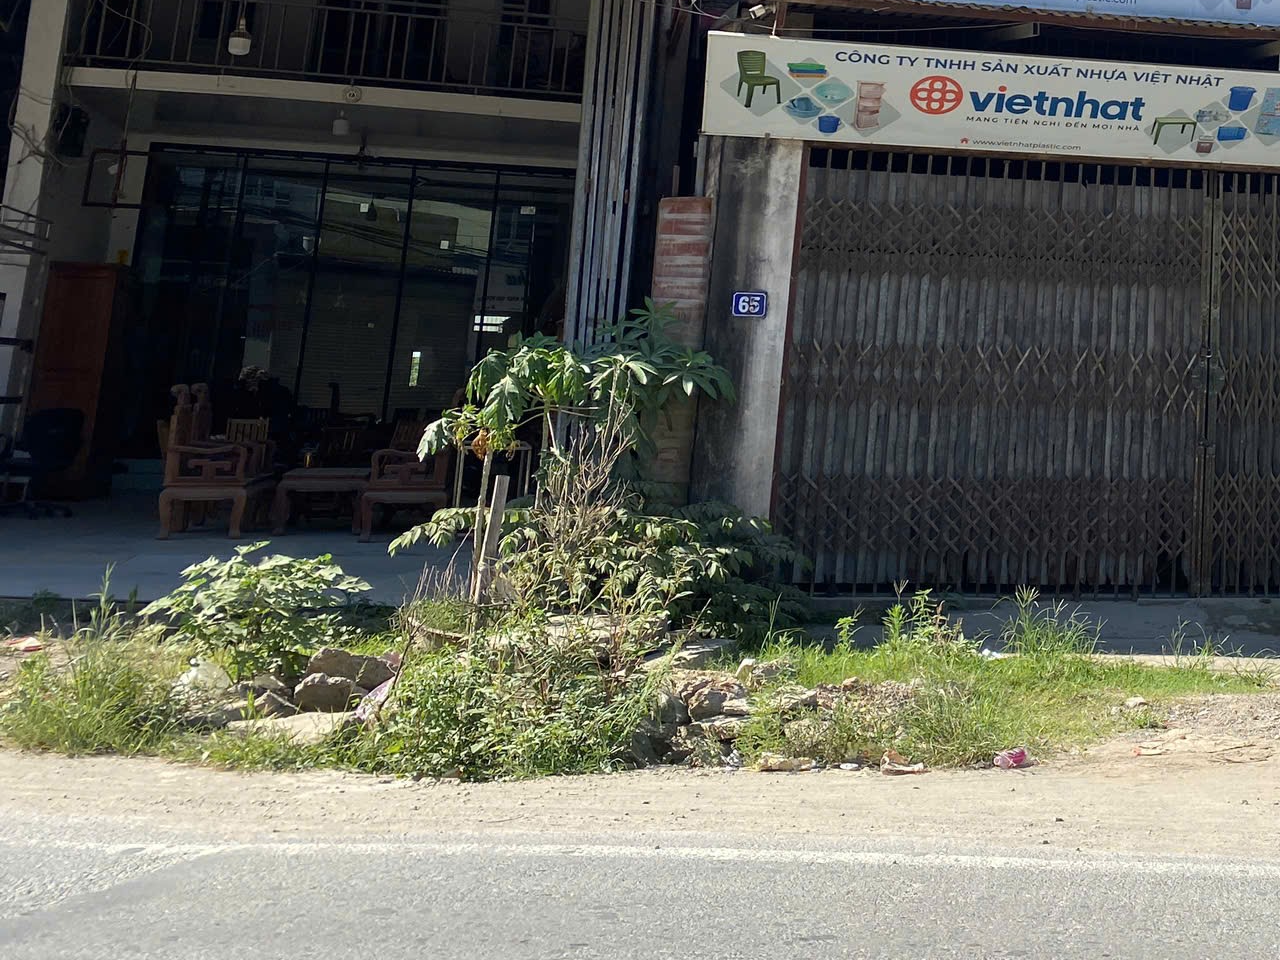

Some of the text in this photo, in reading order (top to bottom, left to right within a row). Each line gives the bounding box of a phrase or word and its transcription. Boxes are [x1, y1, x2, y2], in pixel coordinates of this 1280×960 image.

[835, 49, 890, 66] CÔNG
[896, 55, 919, 67] TY
[924, 57, 976, 71] TNHH
[981, 58, 1018, 74] SẢN
[1024, 62, 1072, 79] XUẤT
[1133, 70, 1171, 85] VIỆT
[1175, 74, 1225, 88] NHẬT
[969, 85, 1146, 122] vietnhat
[966, 115, 999, 123] MANG
[972, 139, 1082, 151] www.vietnhatplastic.com
[738, 295, 761, 313] 65
